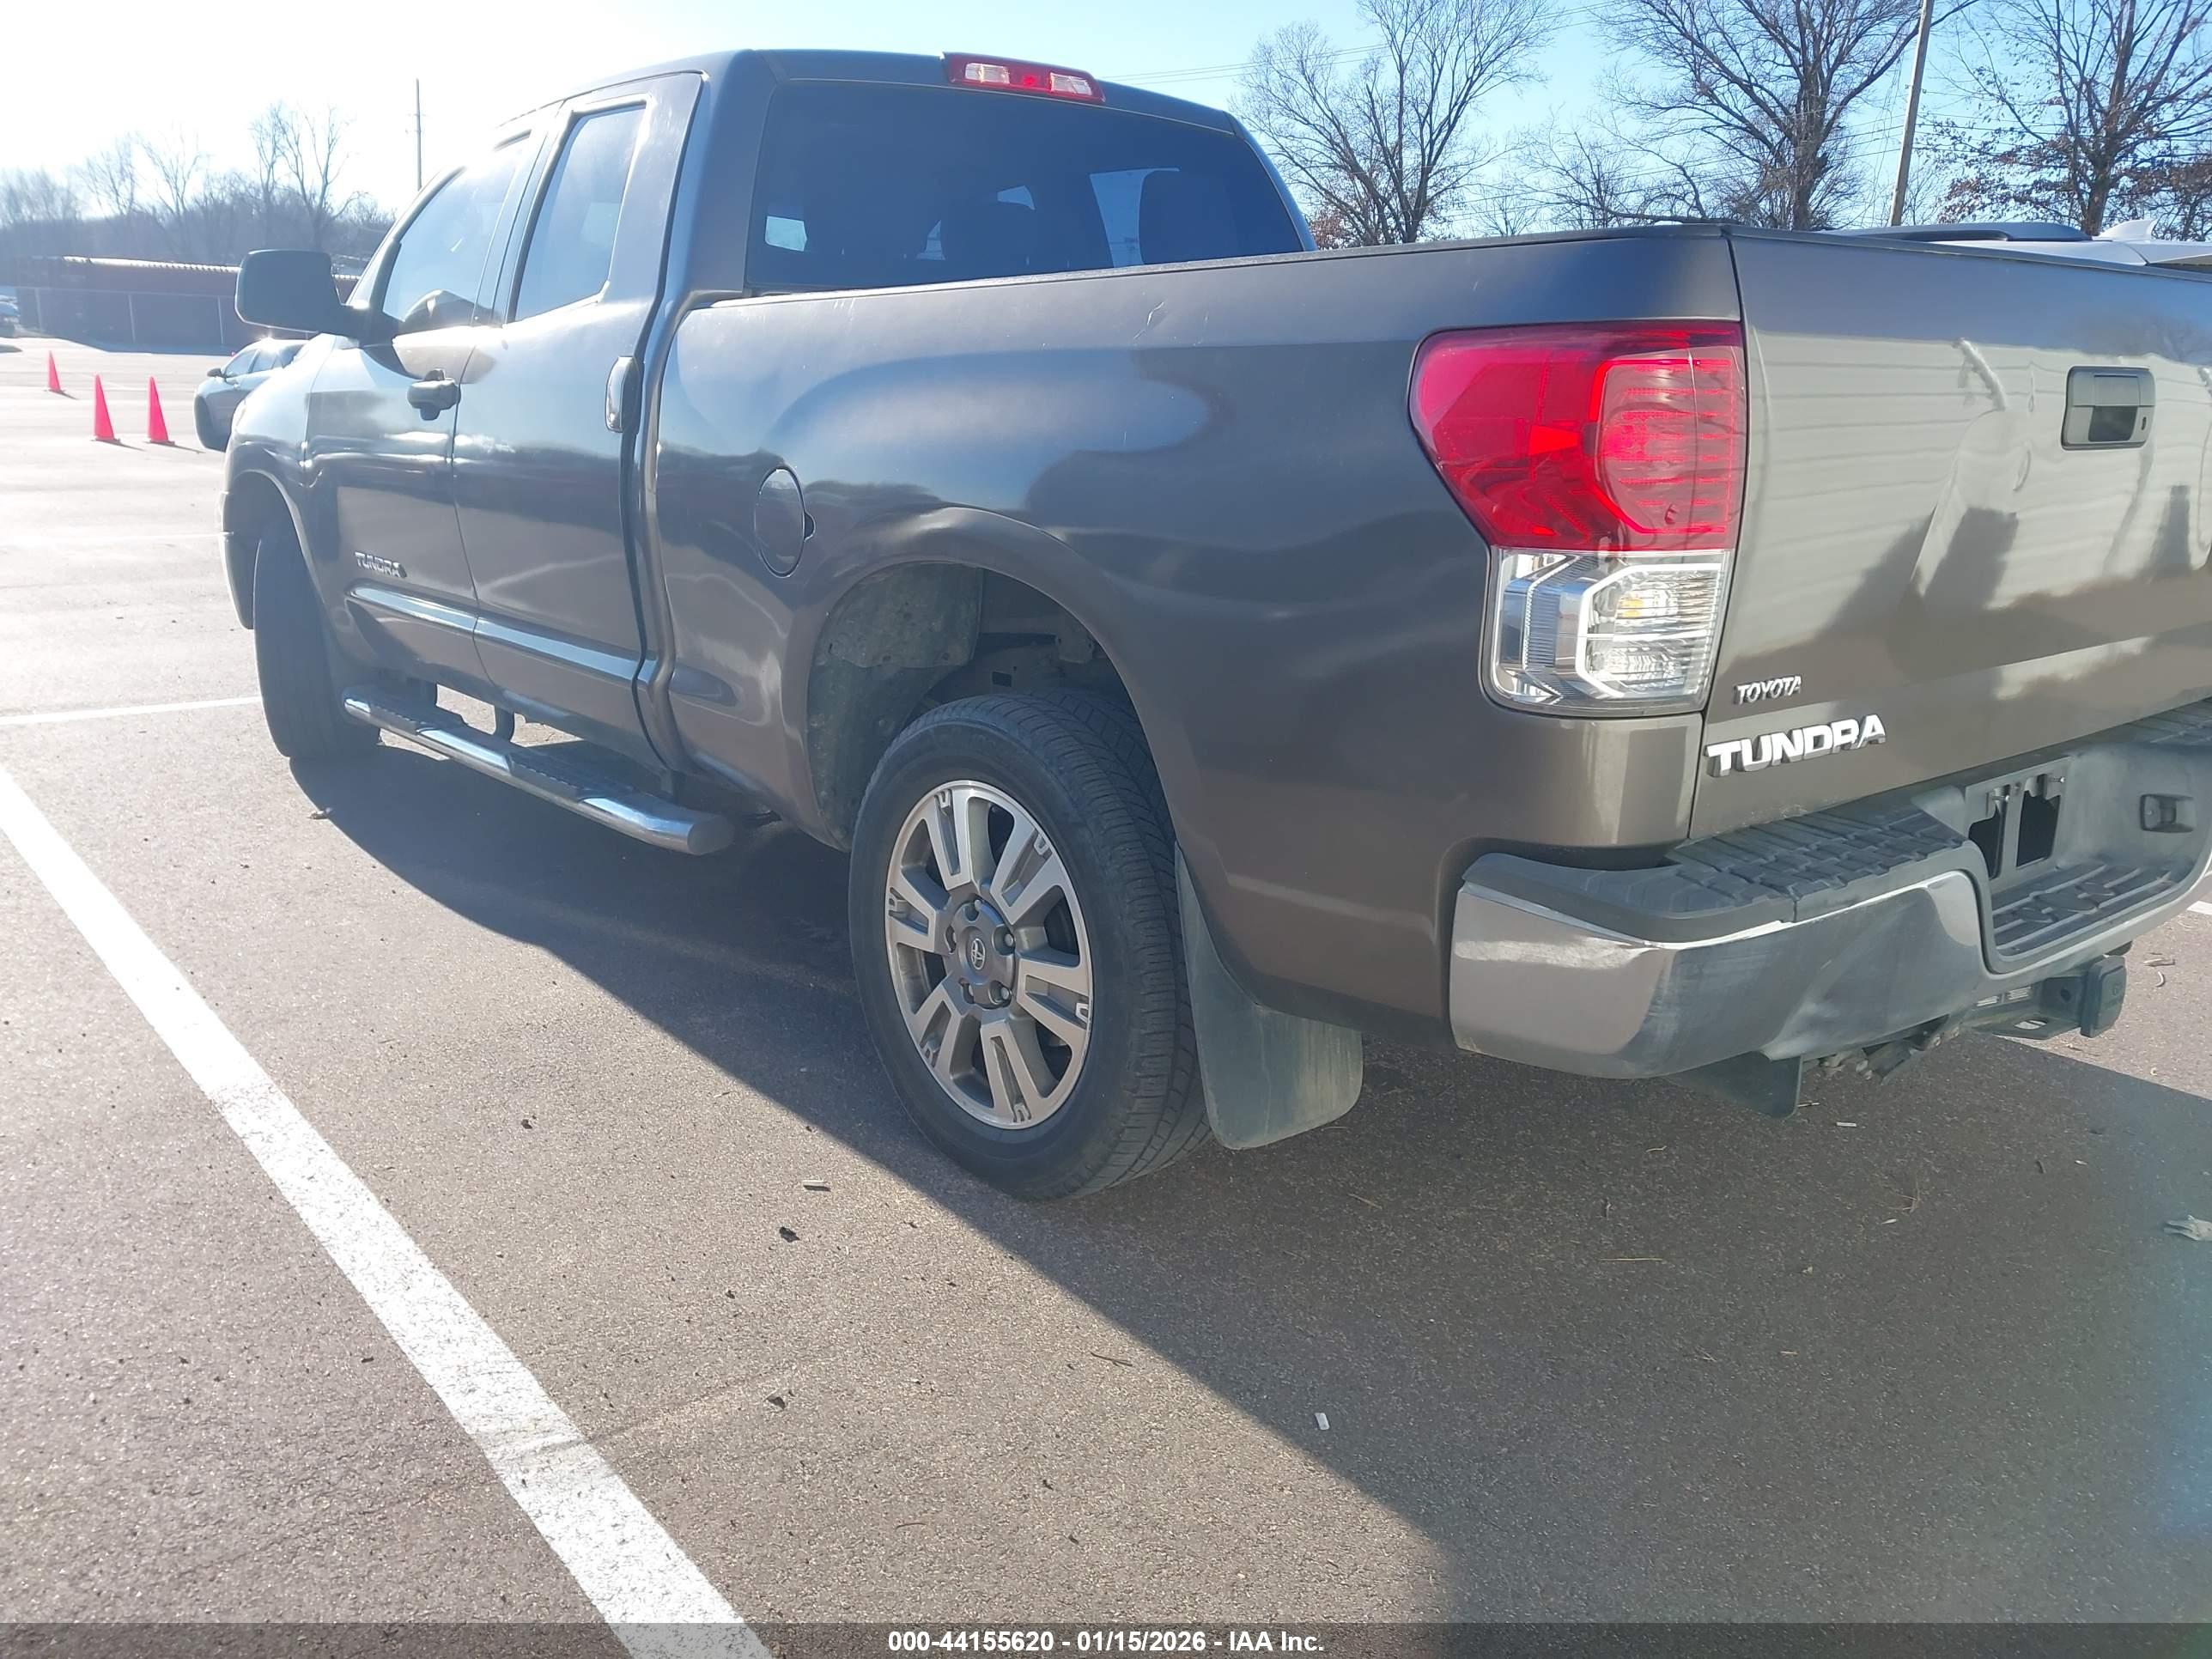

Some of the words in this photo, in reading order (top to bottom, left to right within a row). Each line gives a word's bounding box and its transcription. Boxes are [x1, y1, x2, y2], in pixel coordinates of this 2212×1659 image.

[354, 550, 407, 579] TUNDRA
[1735, 675, 1802, 705] TOYOTA
[1705, 714, 1886, 777] TUNDRA
